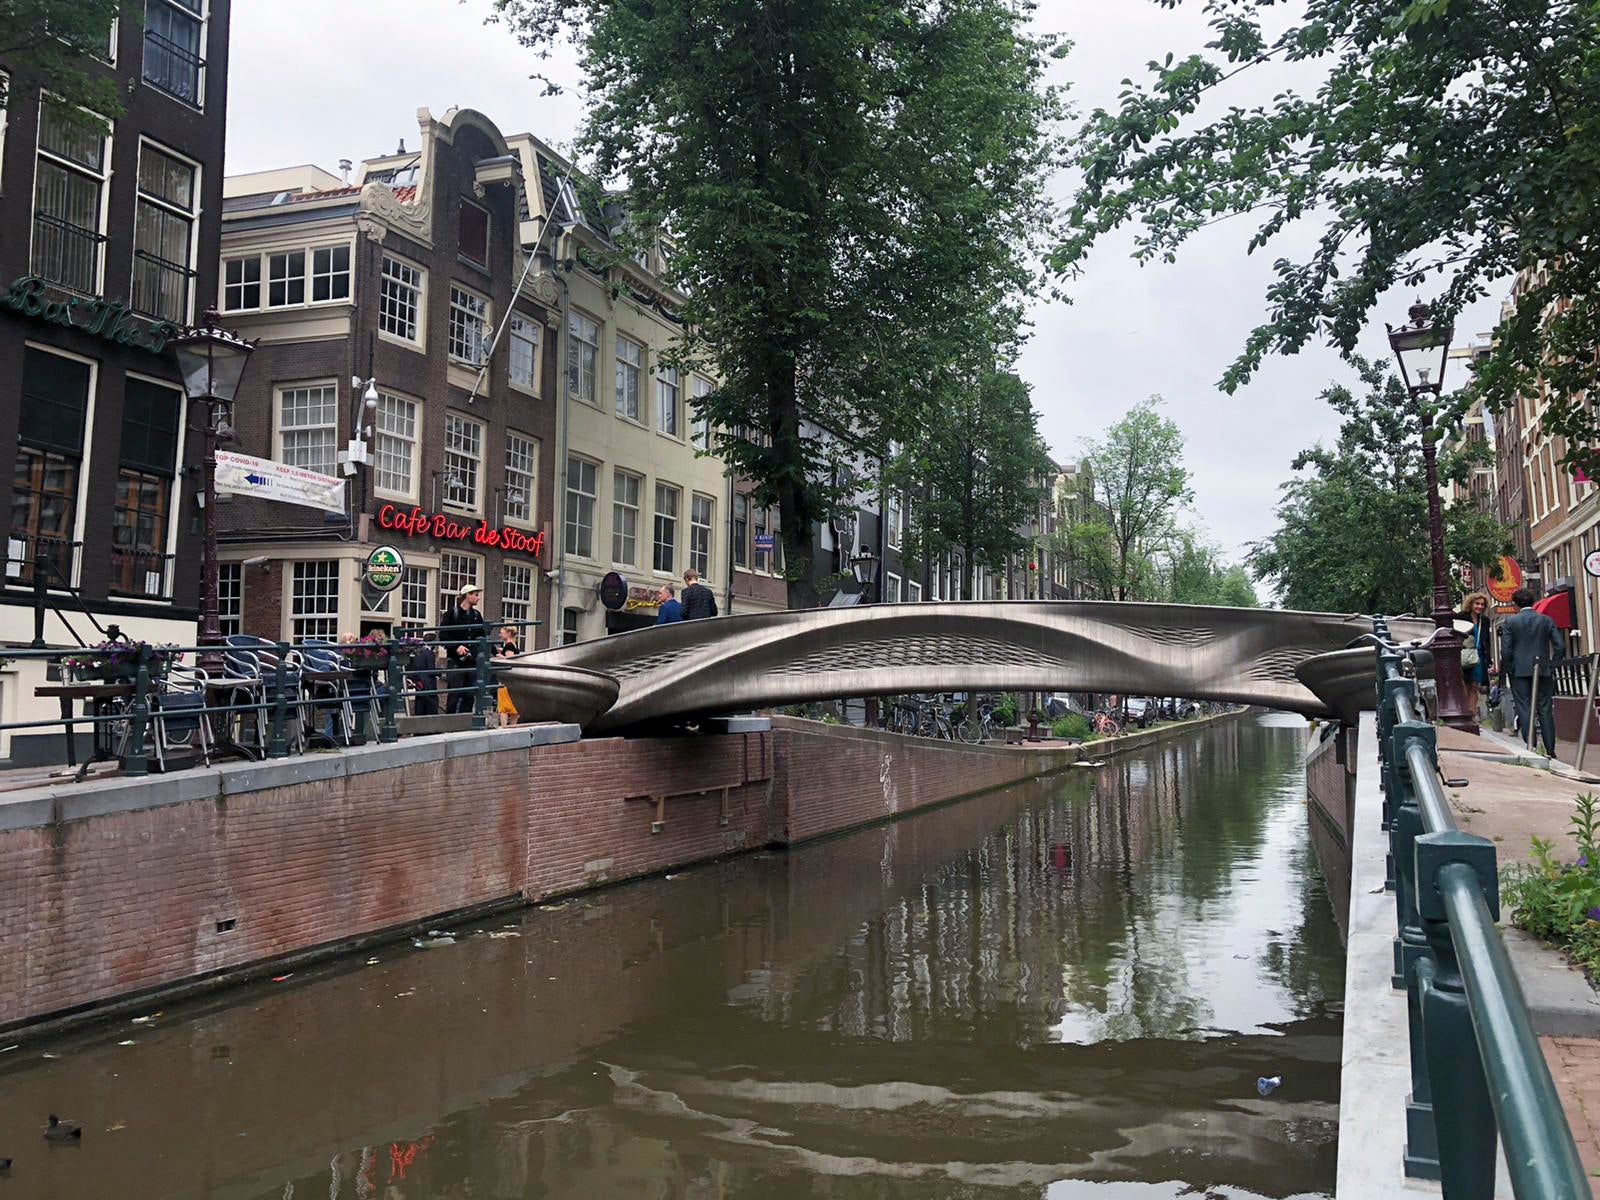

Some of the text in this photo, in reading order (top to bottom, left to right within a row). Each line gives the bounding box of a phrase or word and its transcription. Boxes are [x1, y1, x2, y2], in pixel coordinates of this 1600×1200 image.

[230, 456, 259, 467] COVID-19
[276, 466, 290, 474] KEEP
[379, 504, 545, 557] Cafe Bar de Stoof
[368, 564, 400, 572] Heineken
